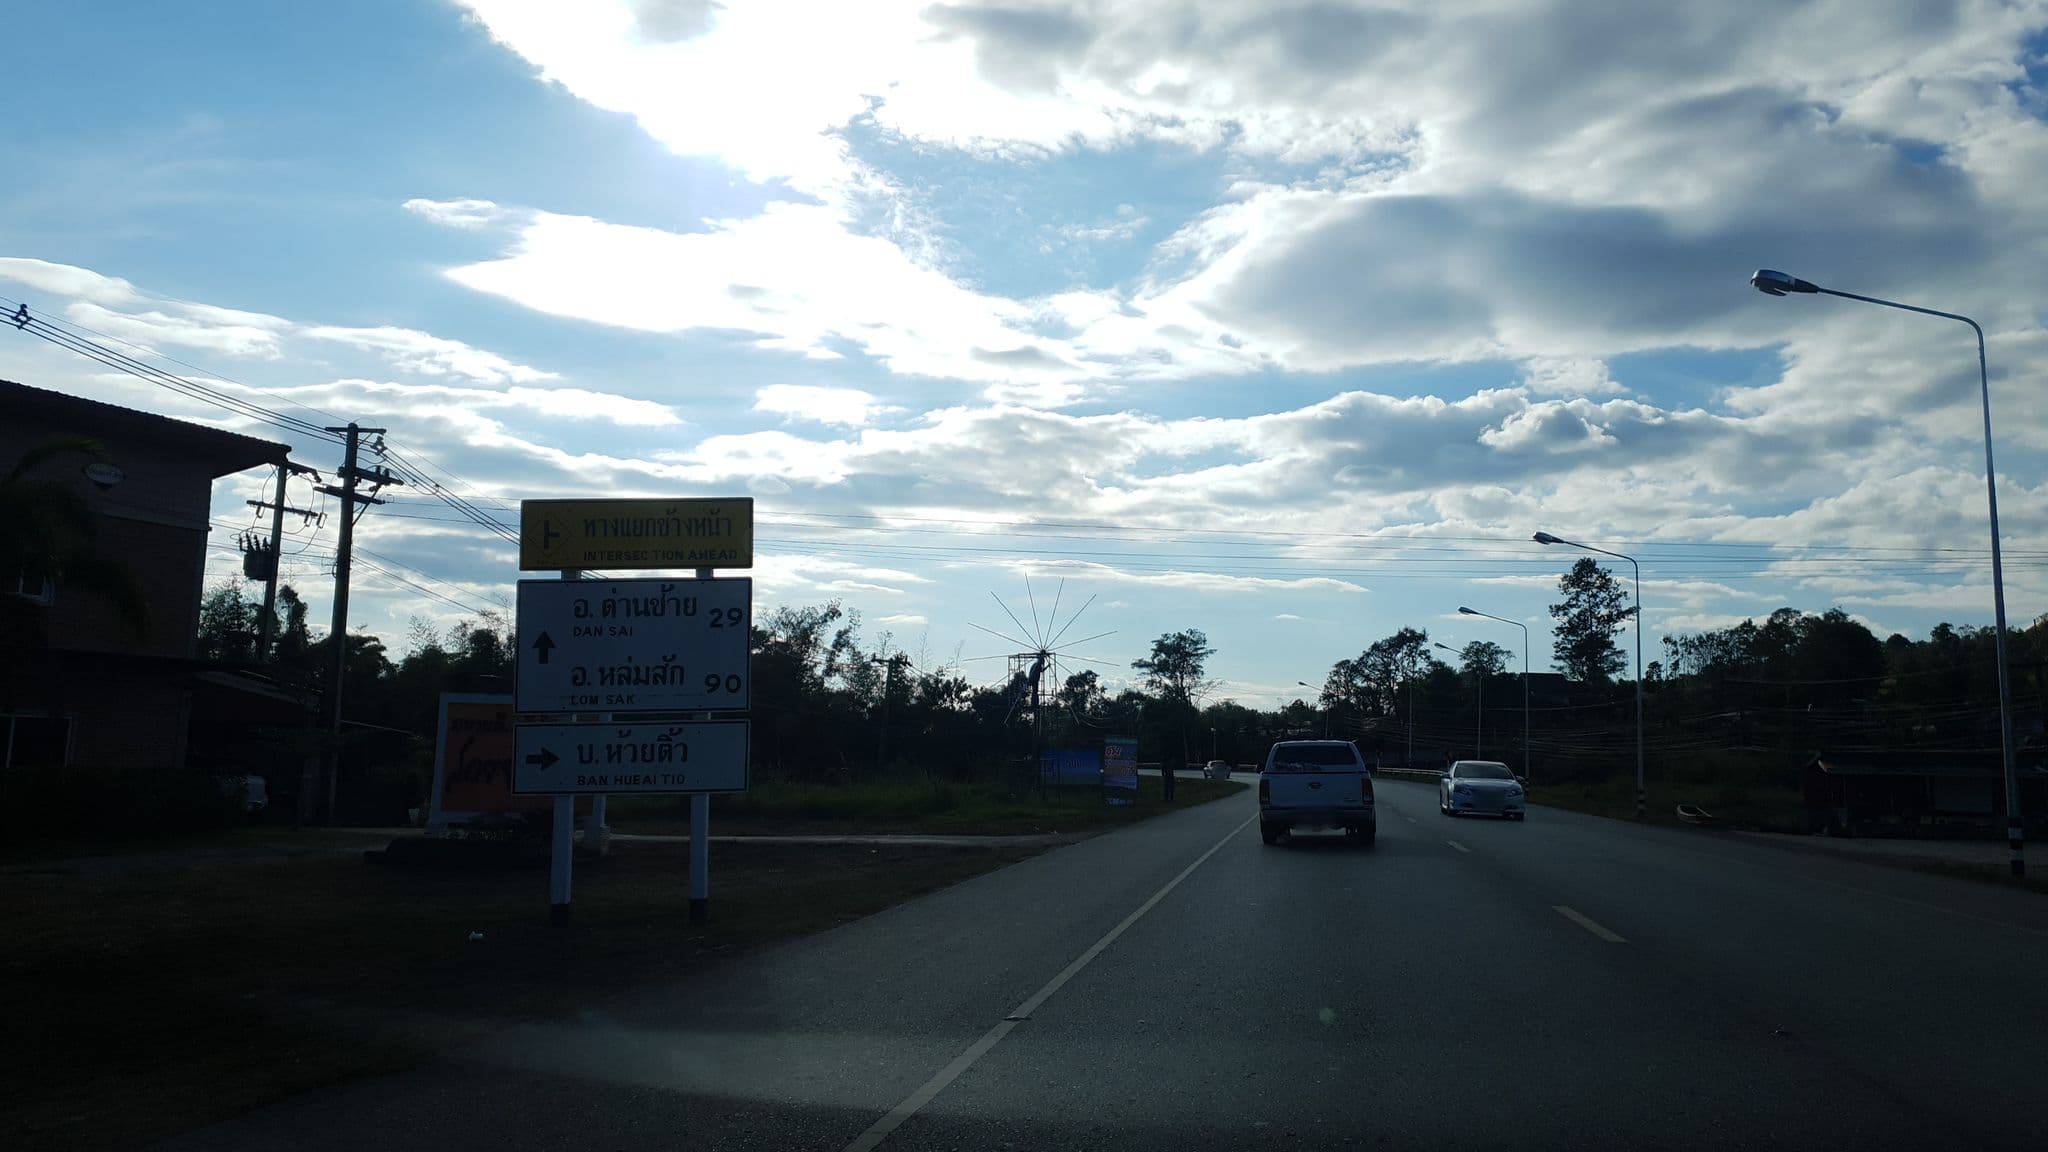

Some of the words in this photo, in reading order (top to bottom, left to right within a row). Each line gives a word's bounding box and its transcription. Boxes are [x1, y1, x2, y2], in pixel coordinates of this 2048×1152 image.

[583, 507, 732, 538] ทางแยกข้างหน้า
[584, 550, 684, 561] INTERSECTION
[687, 550, 738, 560] AHEAD
[573, 598, 594, 618] อ.
[601, 584, 697, 618] ด่านซ้าย
[709, 607, 743, 628] 29
[573, 626, 603, 637] DAN
[608, 626, 633, 636] SAI
[571, 666, 592, 687] อ.
[598, 653, 685, 687] หล่มสัก
[704, 673, 742, 694] 90
[570, 695, 599, 705] LOM
[606, 694, 635, 705] SAK
[577, 743, 599, 764] บ.
[577, 775, 609, 786] BAN
[614, 774, 657, 785] HUEAI
